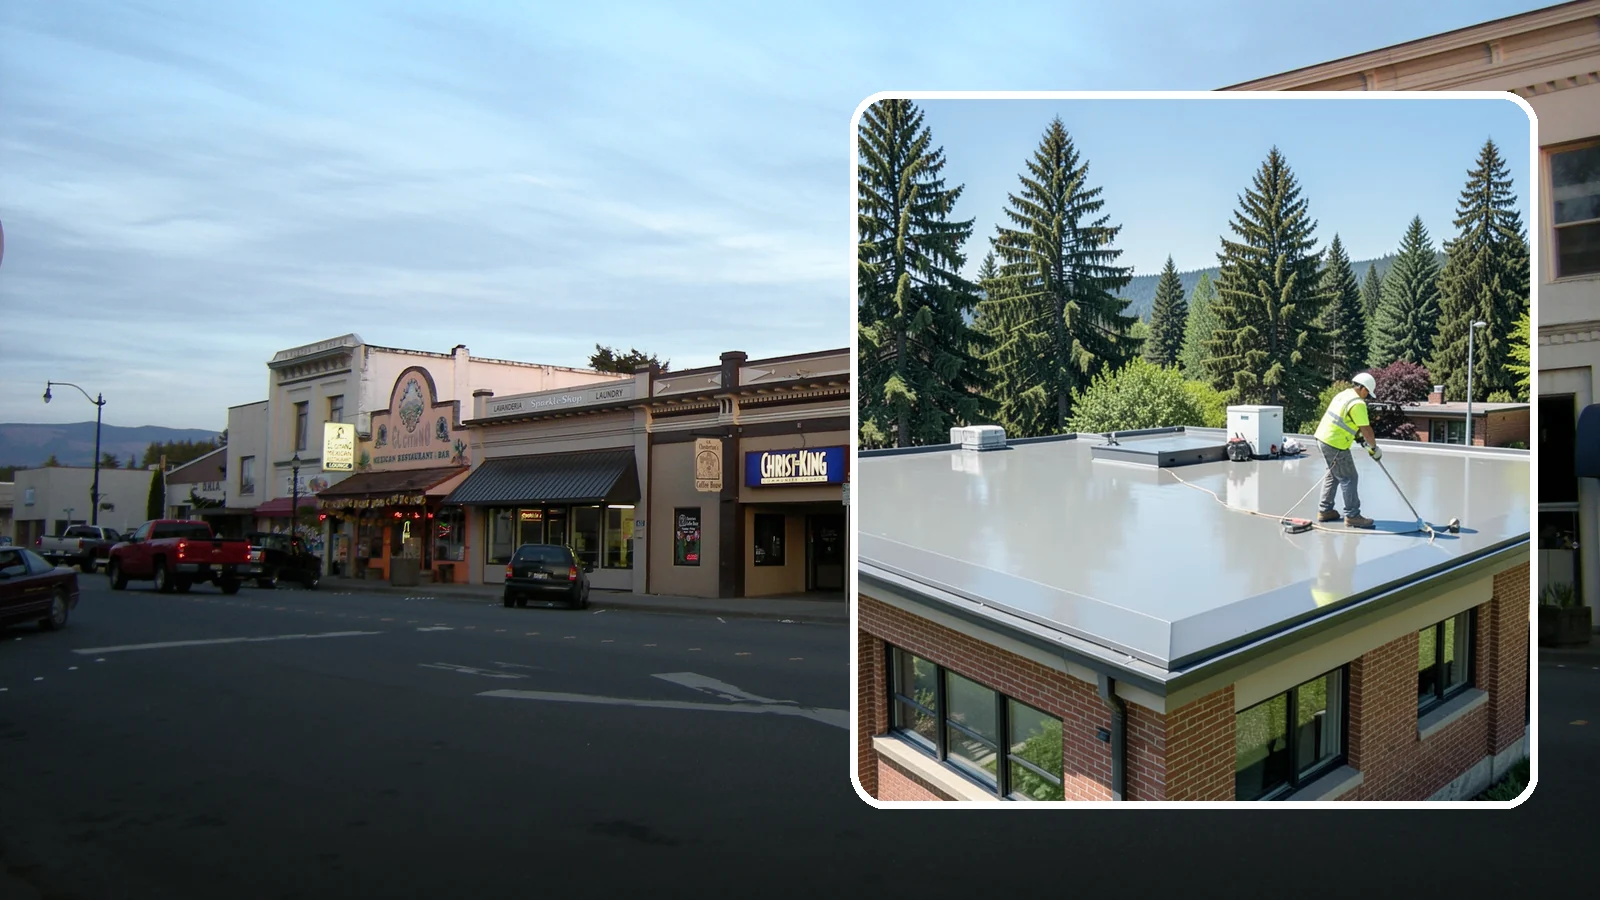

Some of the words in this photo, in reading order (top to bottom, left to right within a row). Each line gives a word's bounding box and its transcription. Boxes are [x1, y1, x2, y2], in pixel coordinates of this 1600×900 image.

[561, 394, 583, 405] Shop
[595, 388, 624, 400] LAUNDRY
[493, 402, 523, 413] LAVANDERIA
[397, 451, 434, 462] RESTAURANT
[438, 450, 450, 459] BAR
[760, 452, 797, 478] CHRIST
[799, 450, 827, 477] KING
